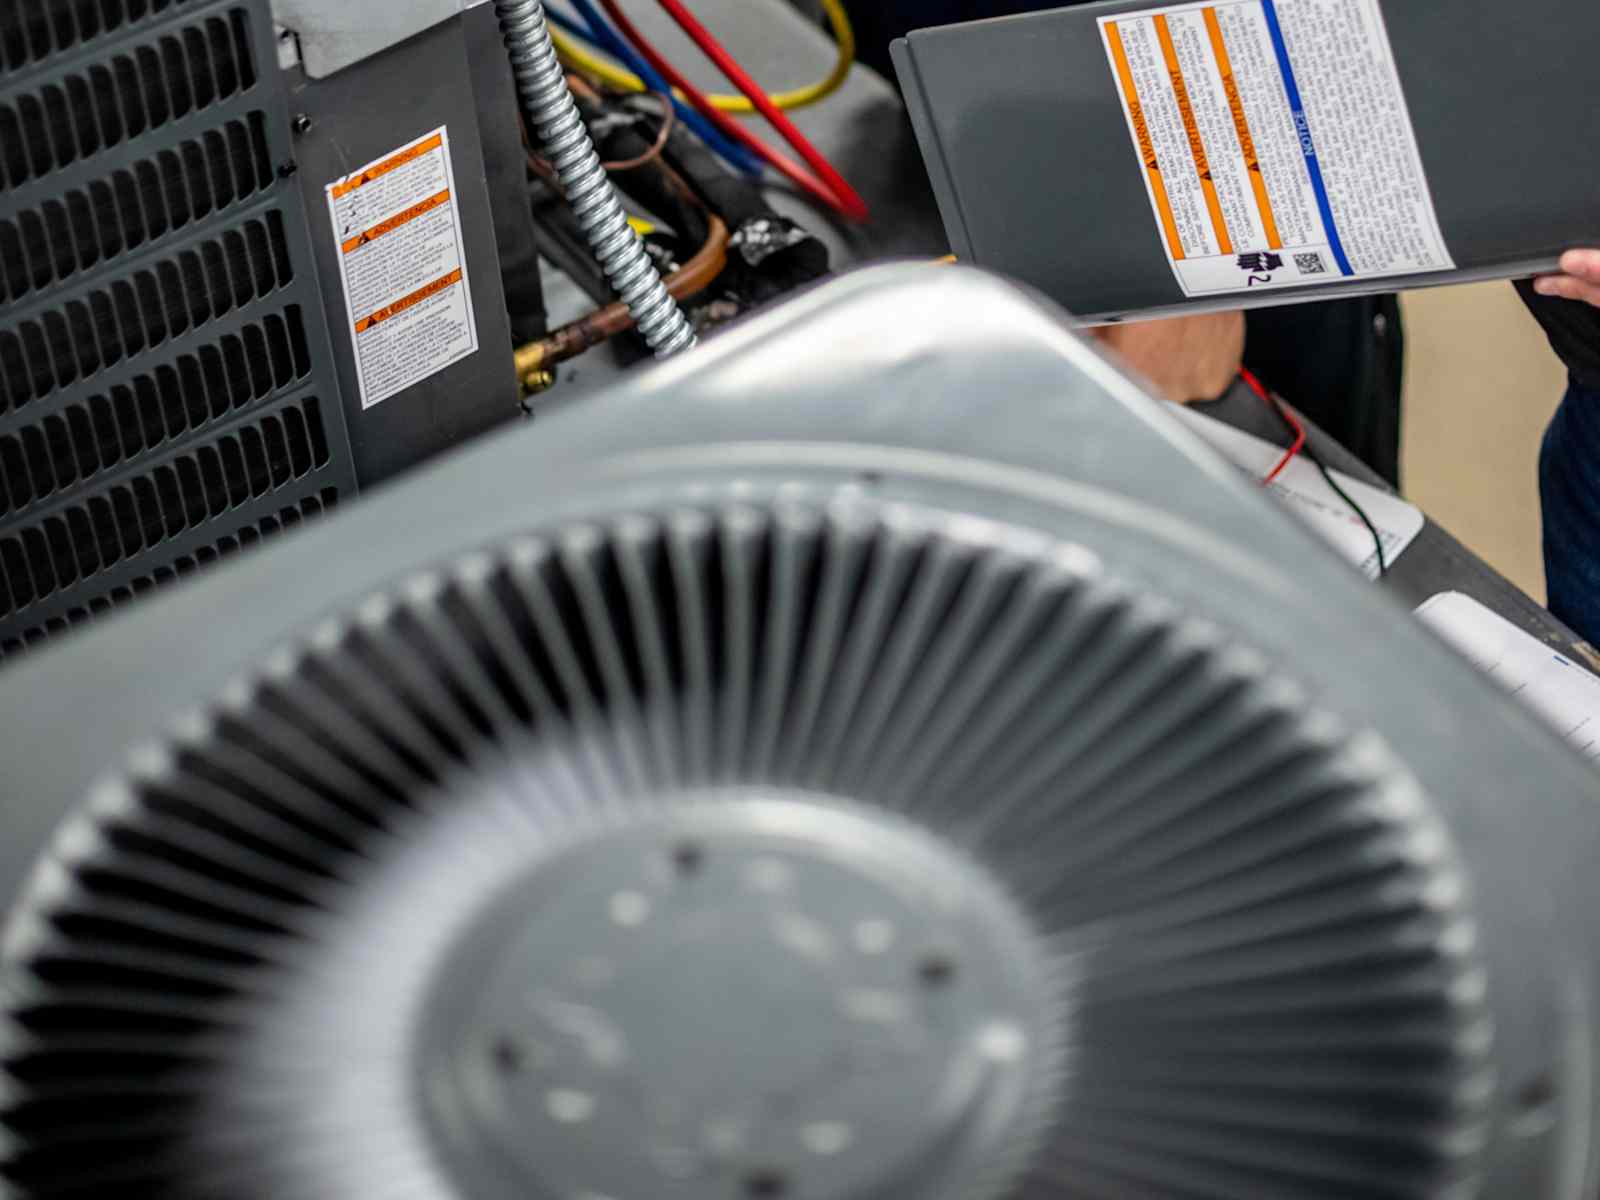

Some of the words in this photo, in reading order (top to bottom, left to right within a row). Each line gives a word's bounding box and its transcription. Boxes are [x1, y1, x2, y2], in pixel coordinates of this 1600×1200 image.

[1129, 101, 1155, 159] WARNING
[1168, 69, 1207, 168] AVERTISSEMENT
[1221, 73, 1256, 159] ADVERTENCIA
[1292, 109, 1315, 155] NOTICE
